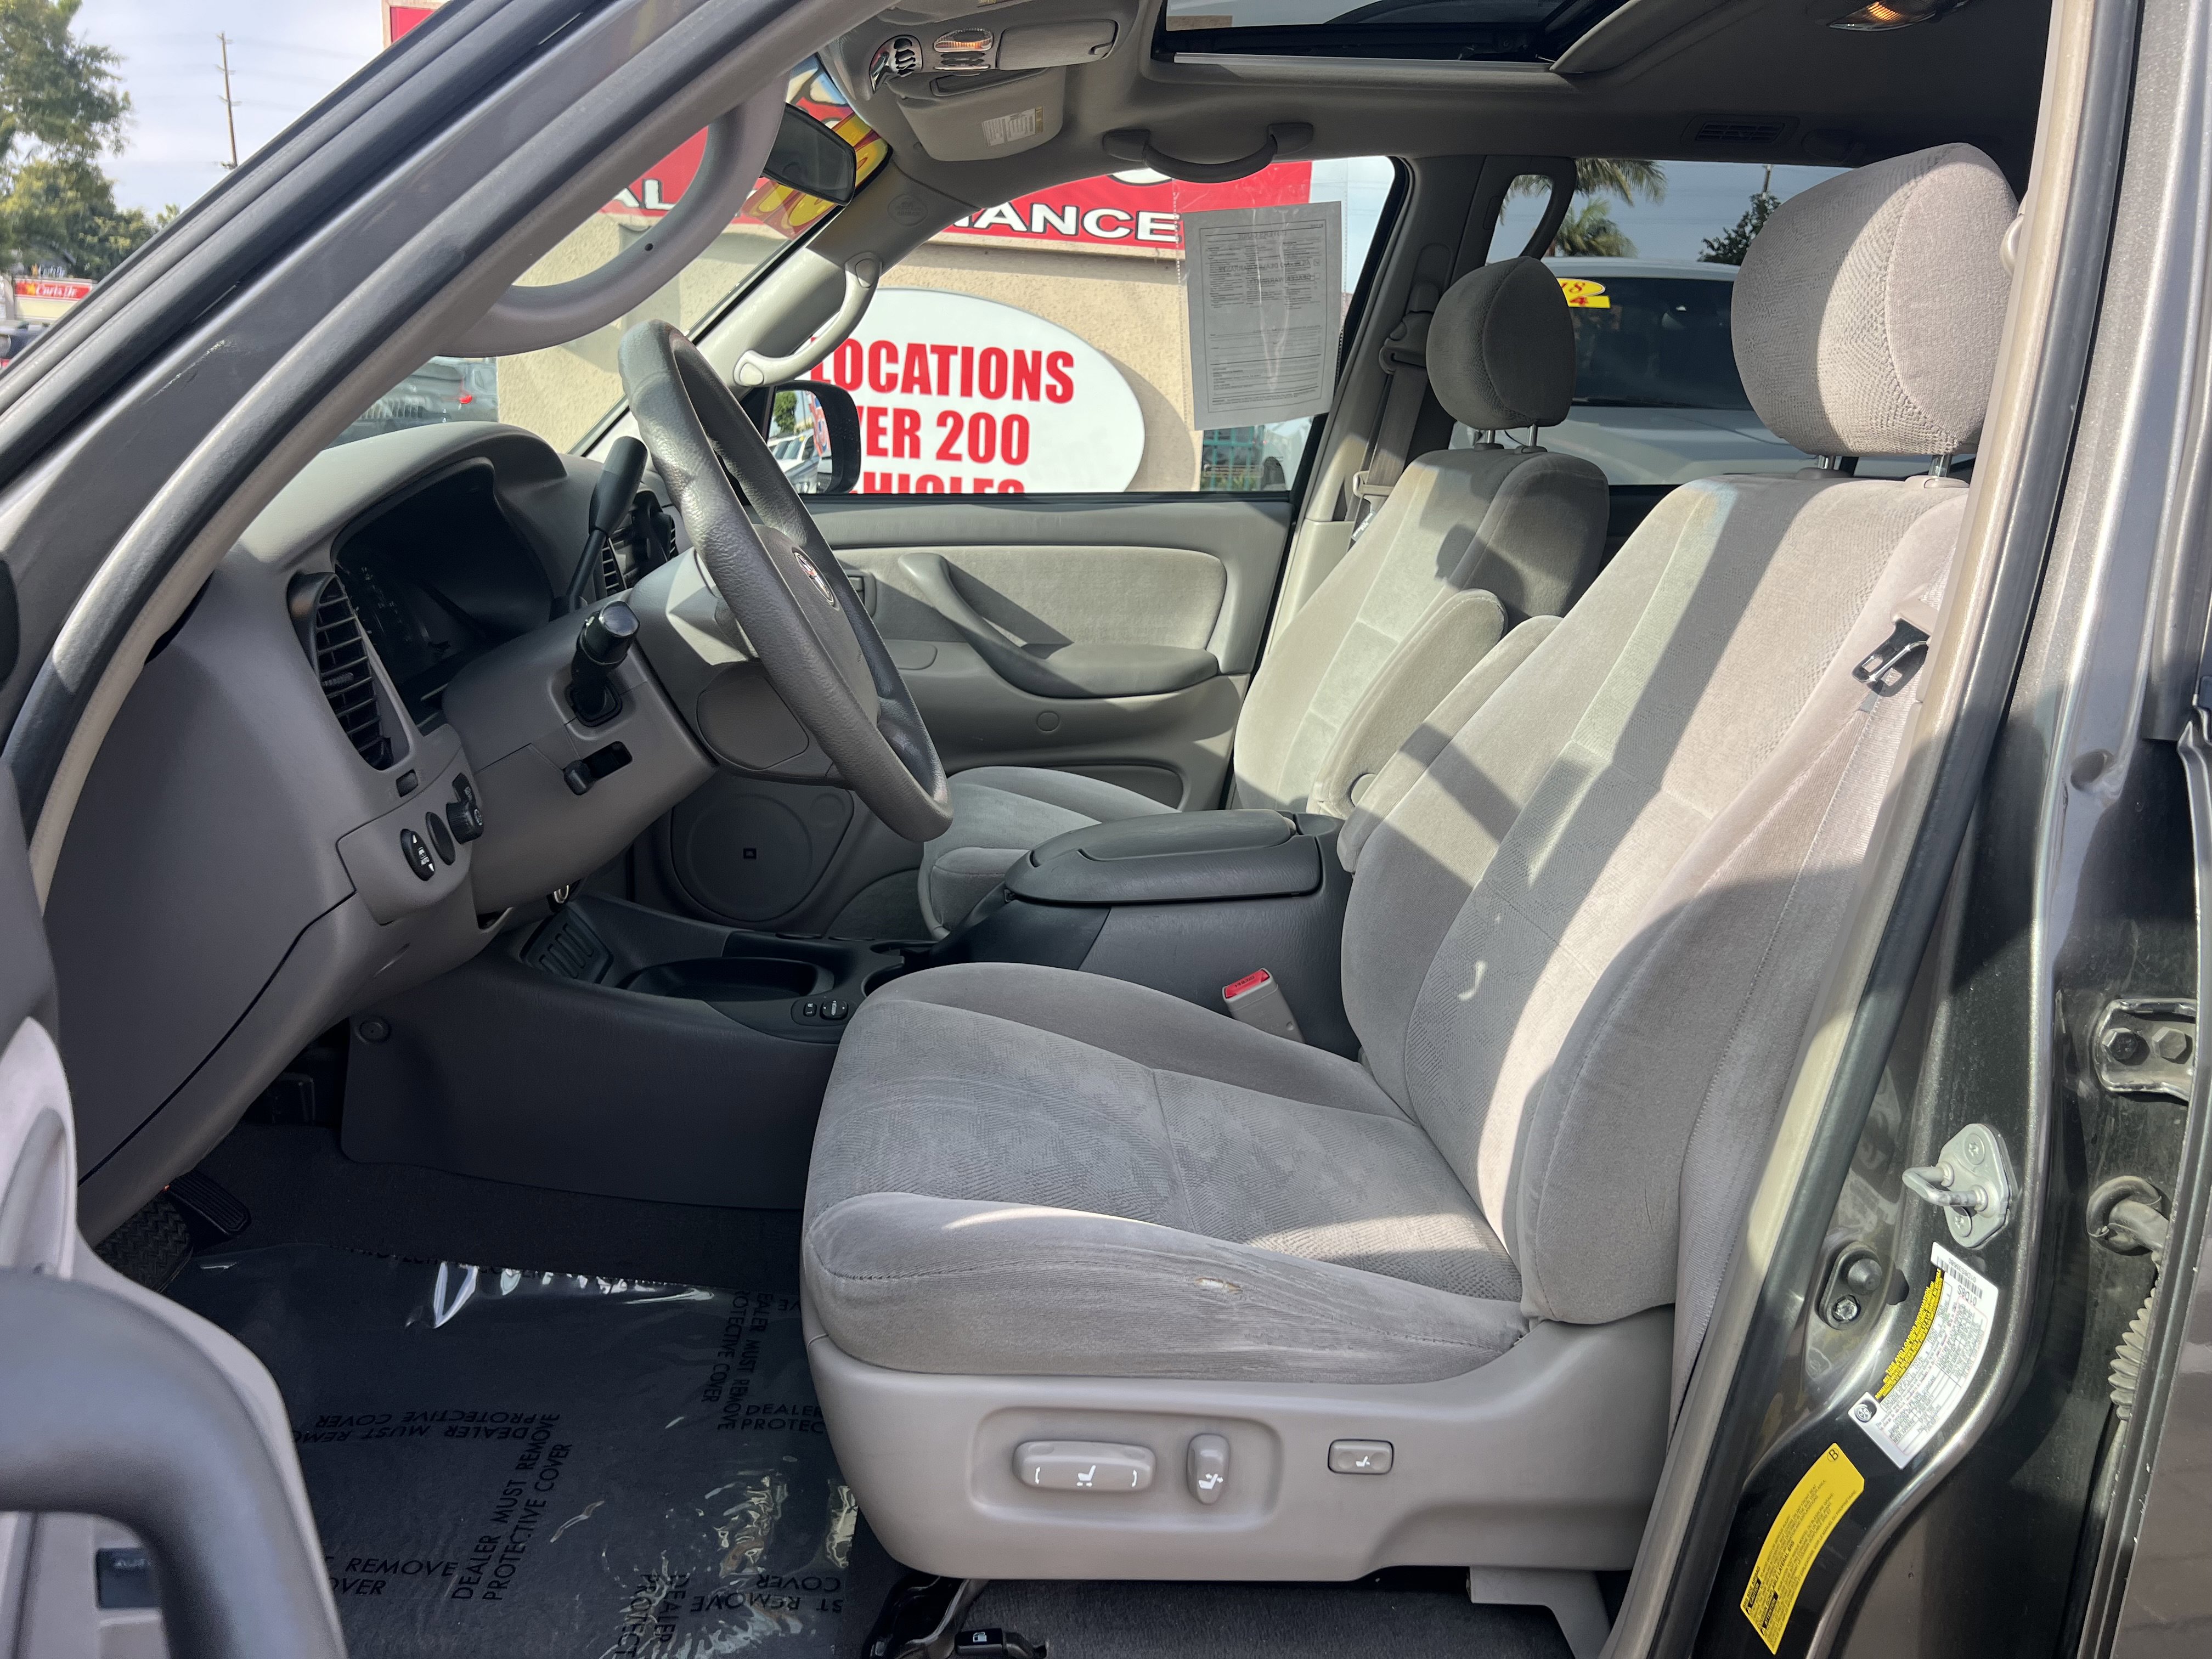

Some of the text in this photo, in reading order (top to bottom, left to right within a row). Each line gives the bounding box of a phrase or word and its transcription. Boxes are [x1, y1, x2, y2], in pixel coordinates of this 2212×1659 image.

[859, 405, 1030, 466] ER 200
[717, 1292, 774, 1430] EALER MUST REMOVE
[701, 1363, 731, 1403] COVER
[315, 1410, 537, 1428] PROTECTIVE COVER
[361, 1425, 431, 1440] MUST
[444, 1425, 529, 1440] DEALER
[1828, 1448, 1838, 1461] B
[451, 1413, 560, 1599] DEALER MUST REMOVE
[482, 1443, 572, 1601] PROTECTIVE COVER
[345, 1557, 459, 1577] REMOVE
[756, 1573, 841, 1592] COVER
[690, 1593, 801, 1612] REMOVE
[1764, 1597, 1776, 1626] ATTENTION
